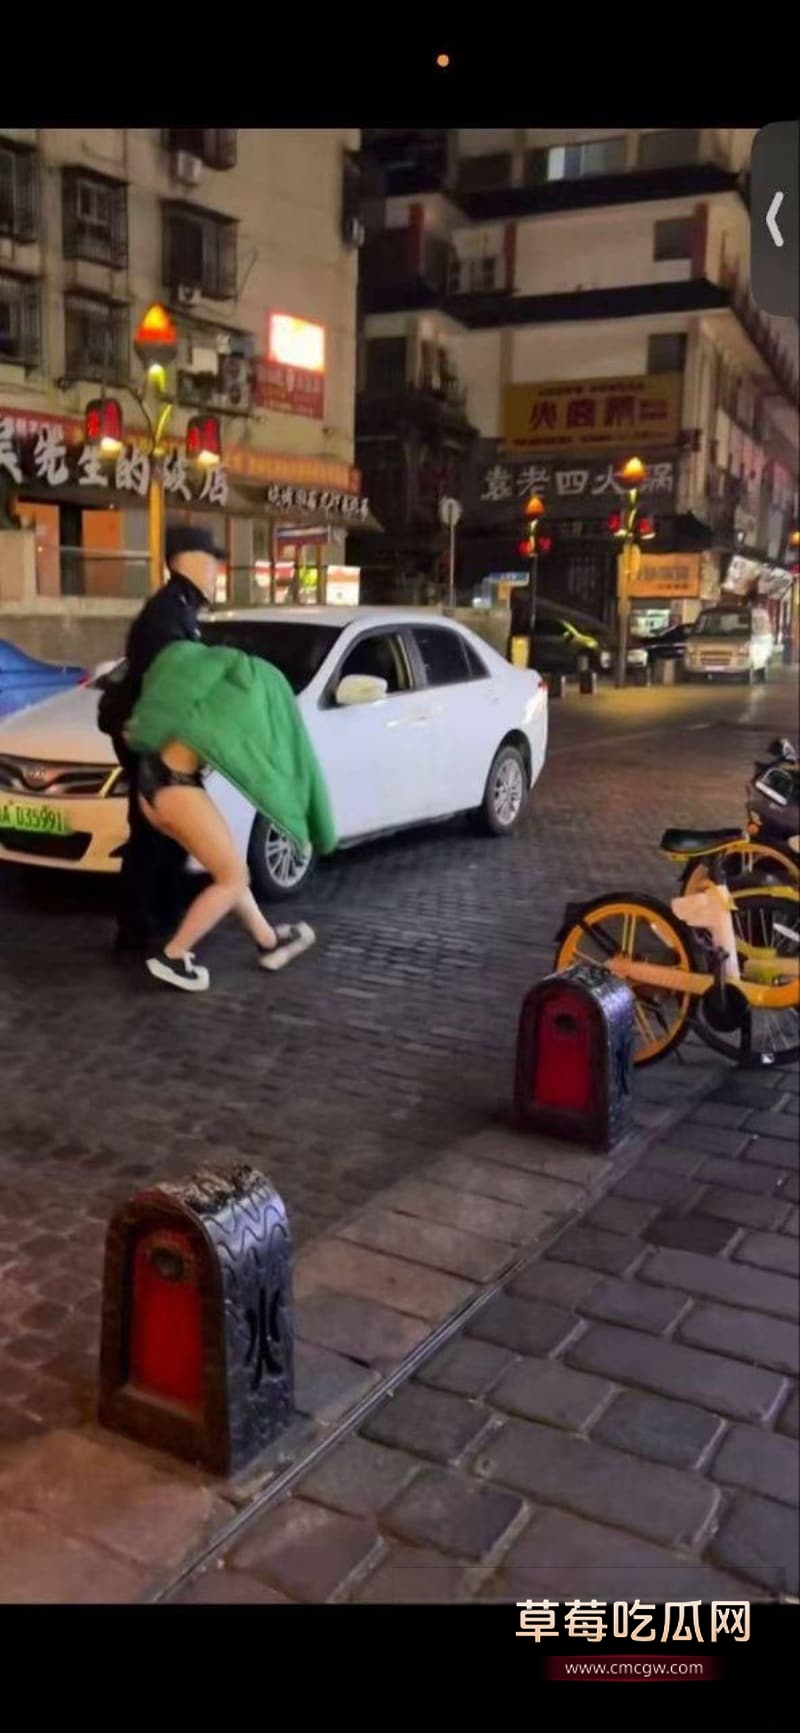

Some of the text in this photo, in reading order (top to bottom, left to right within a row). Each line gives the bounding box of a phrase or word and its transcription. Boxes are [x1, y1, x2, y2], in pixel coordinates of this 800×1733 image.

[481, 462, 674, 502] 袁老四火锅
